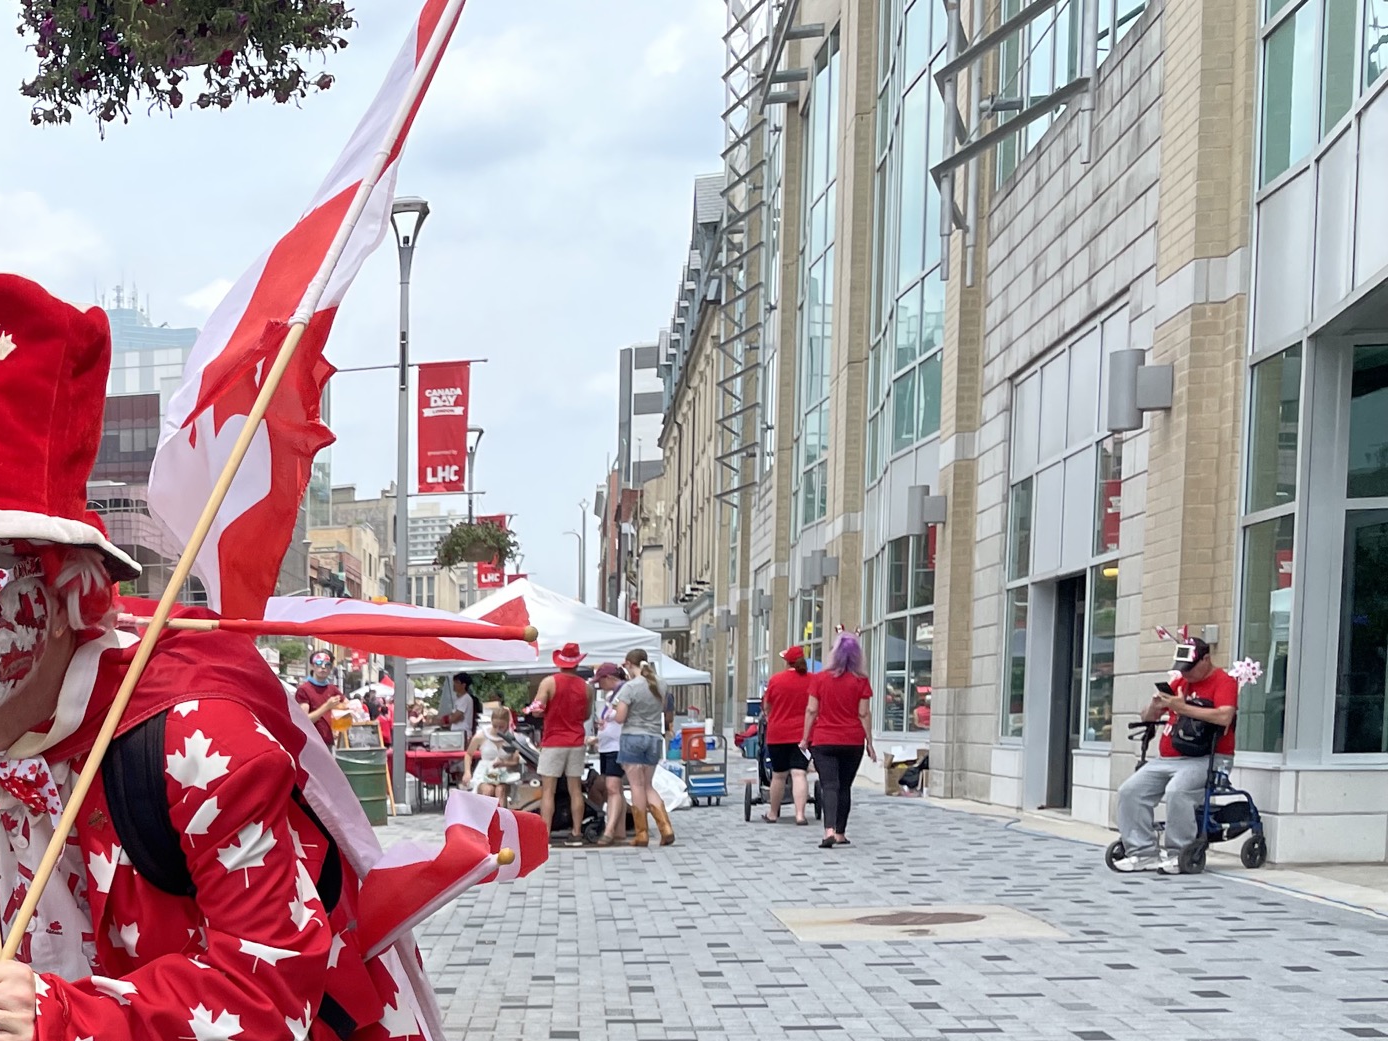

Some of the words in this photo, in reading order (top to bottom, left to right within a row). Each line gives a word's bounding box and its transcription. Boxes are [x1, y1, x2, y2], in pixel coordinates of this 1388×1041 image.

[425, 388, 462, 397] CANADA
[430, 395, 457, 407] DAY
[426, 465, 459, 483] LHC
[481, 573, 500, 583] LHC
